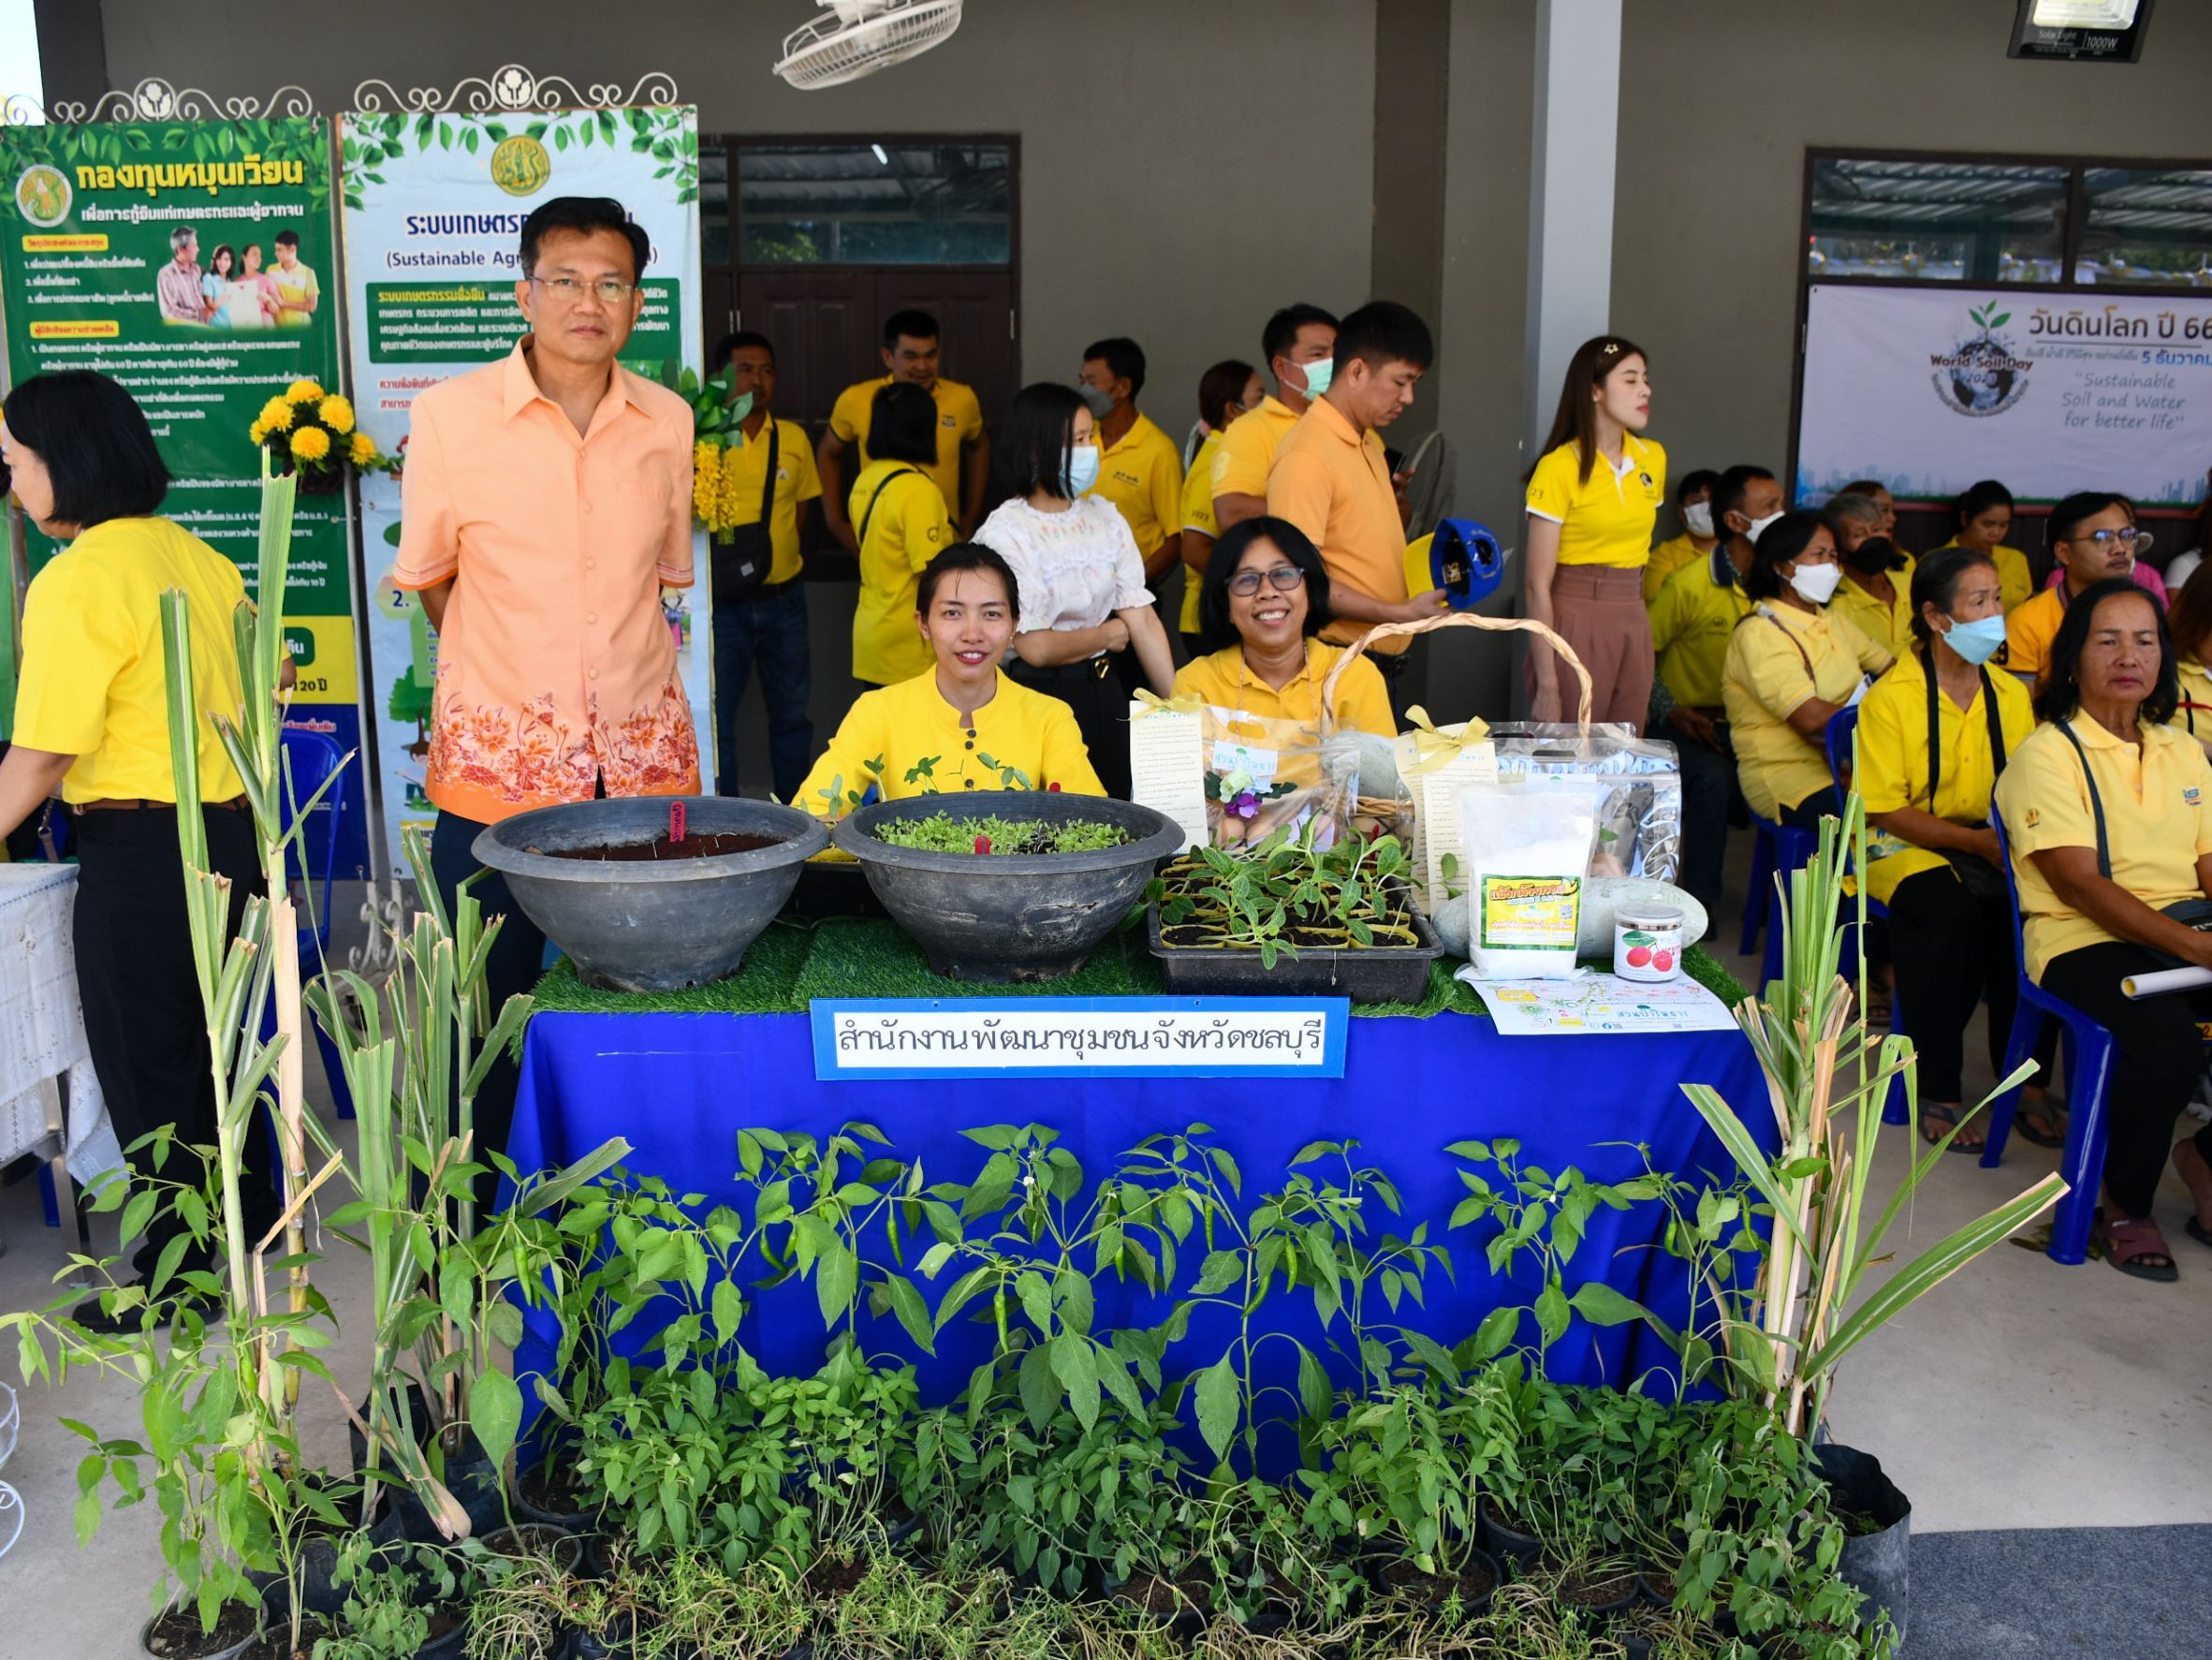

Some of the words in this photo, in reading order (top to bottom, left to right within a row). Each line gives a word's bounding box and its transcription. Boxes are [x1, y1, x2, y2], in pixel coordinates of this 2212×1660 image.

[2087, 36, 2118, 49] 1000W
[76, 154, 303, 198] กองทุนหมุนเวียน
[81, 201, 303, 224] เพื่อการกู้ยืมแก่เกษตรกรและผู้ยากจน
[406, 214, 530, 235] ระบบเกษตร
[387, 251, 485, 269] (Sustainable
[492, 251, 520, 269] Agr
[2029, 304, 2148, 338] วันดินโลก
[2157, 311, 2176, 339] ปี
[1930, 354, 1970, 368] World
[1976, 356, 2001, 369] Soil
[2007, 358, 2033, 372] Day
[2142, 350, 2151, 364] 5
[2061, 391, 2092, 407] Soil
[2097, 392, 2129, 407] and
[2135, 394, 2186, 409] Water
[2064, 410, 2089, 428] for
[2095, 411, 2145, 429] better
[392, 590, 410, 608] 2.
[300, 680, 316, 692] 20
[839, 1017, 1323, 1061] สำนักงานพัฒนาชุมชนจังหวัดชลบุรี
